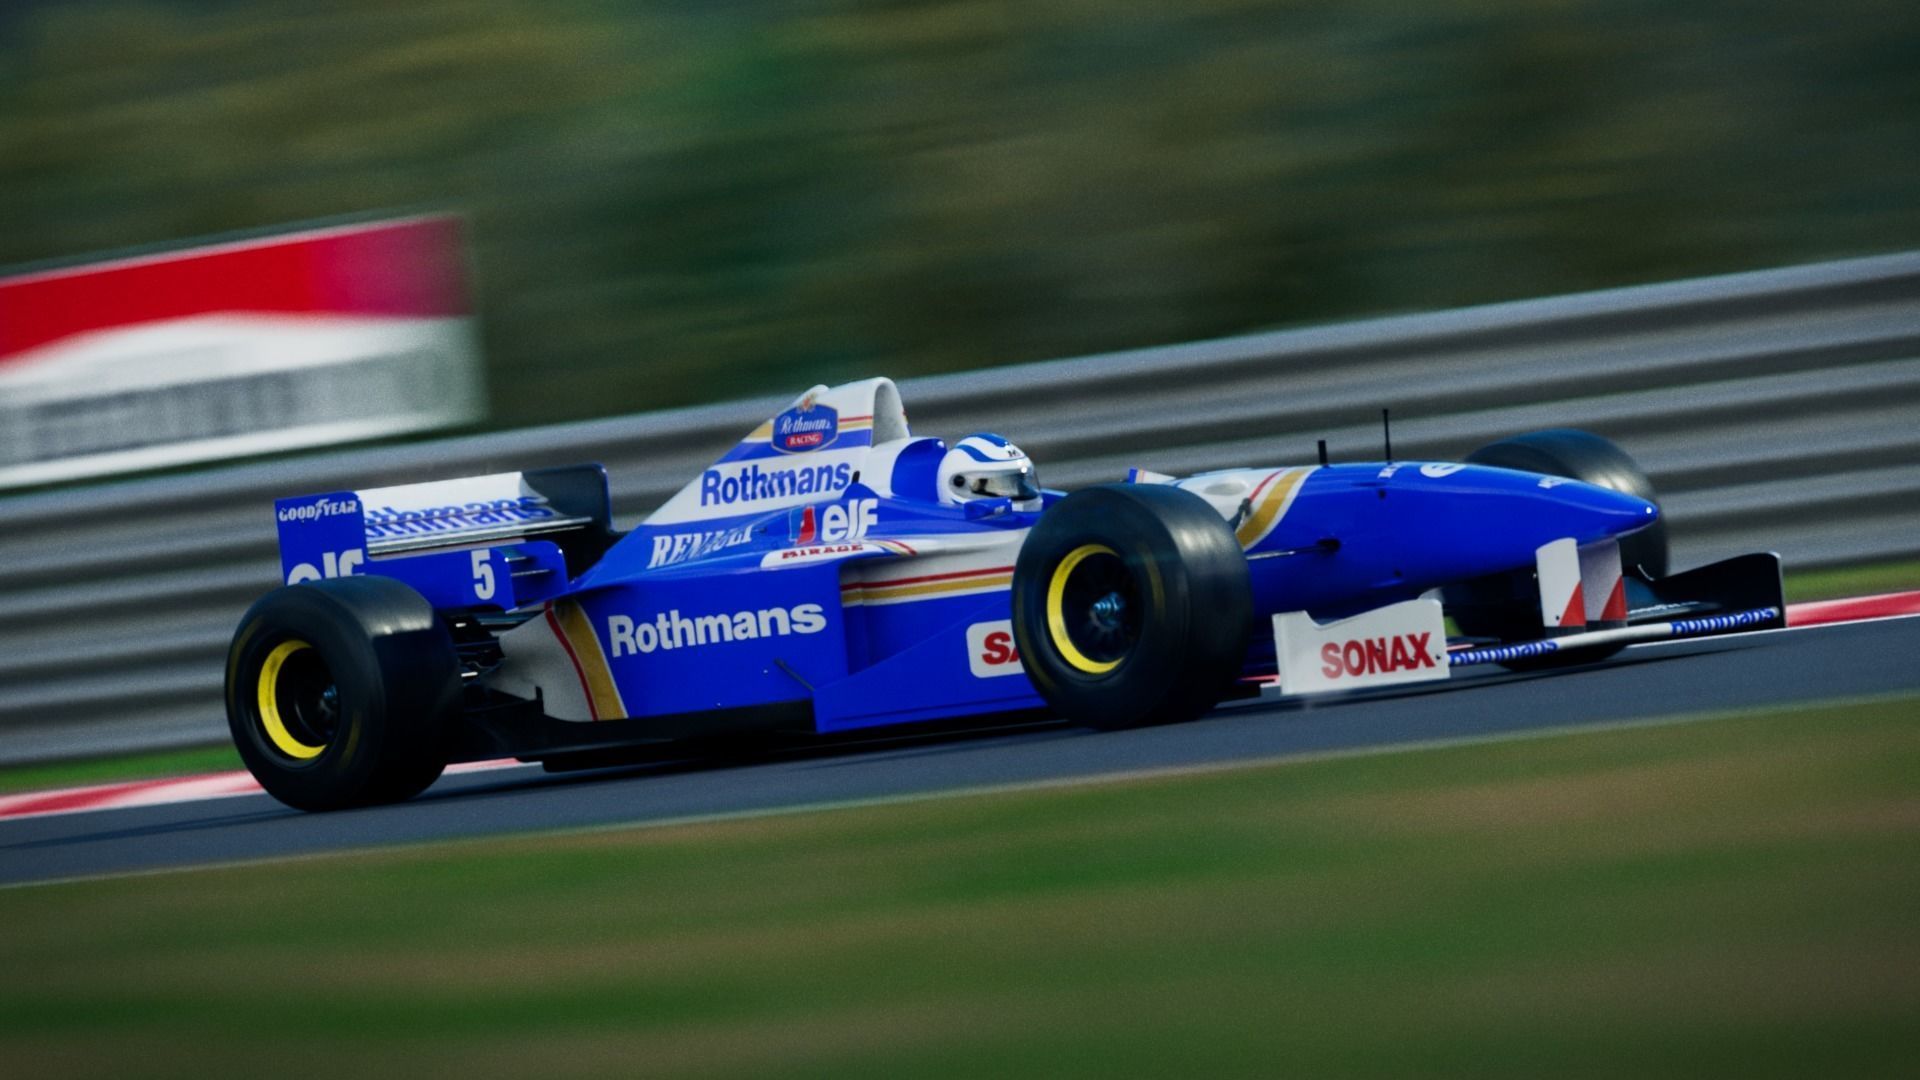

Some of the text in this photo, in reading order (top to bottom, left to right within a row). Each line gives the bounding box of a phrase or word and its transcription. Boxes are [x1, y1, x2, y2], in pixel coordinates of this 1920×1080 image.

[790, 434, 819, 446] RACING
[701, 462, 851, 507] Rothmans
[821, 499, 878, 542] elf
[471, 549, 495, 600] 5
[608, 603, 827, 657] Rothmans
[1321, 632, 1436, 678] SONAX
